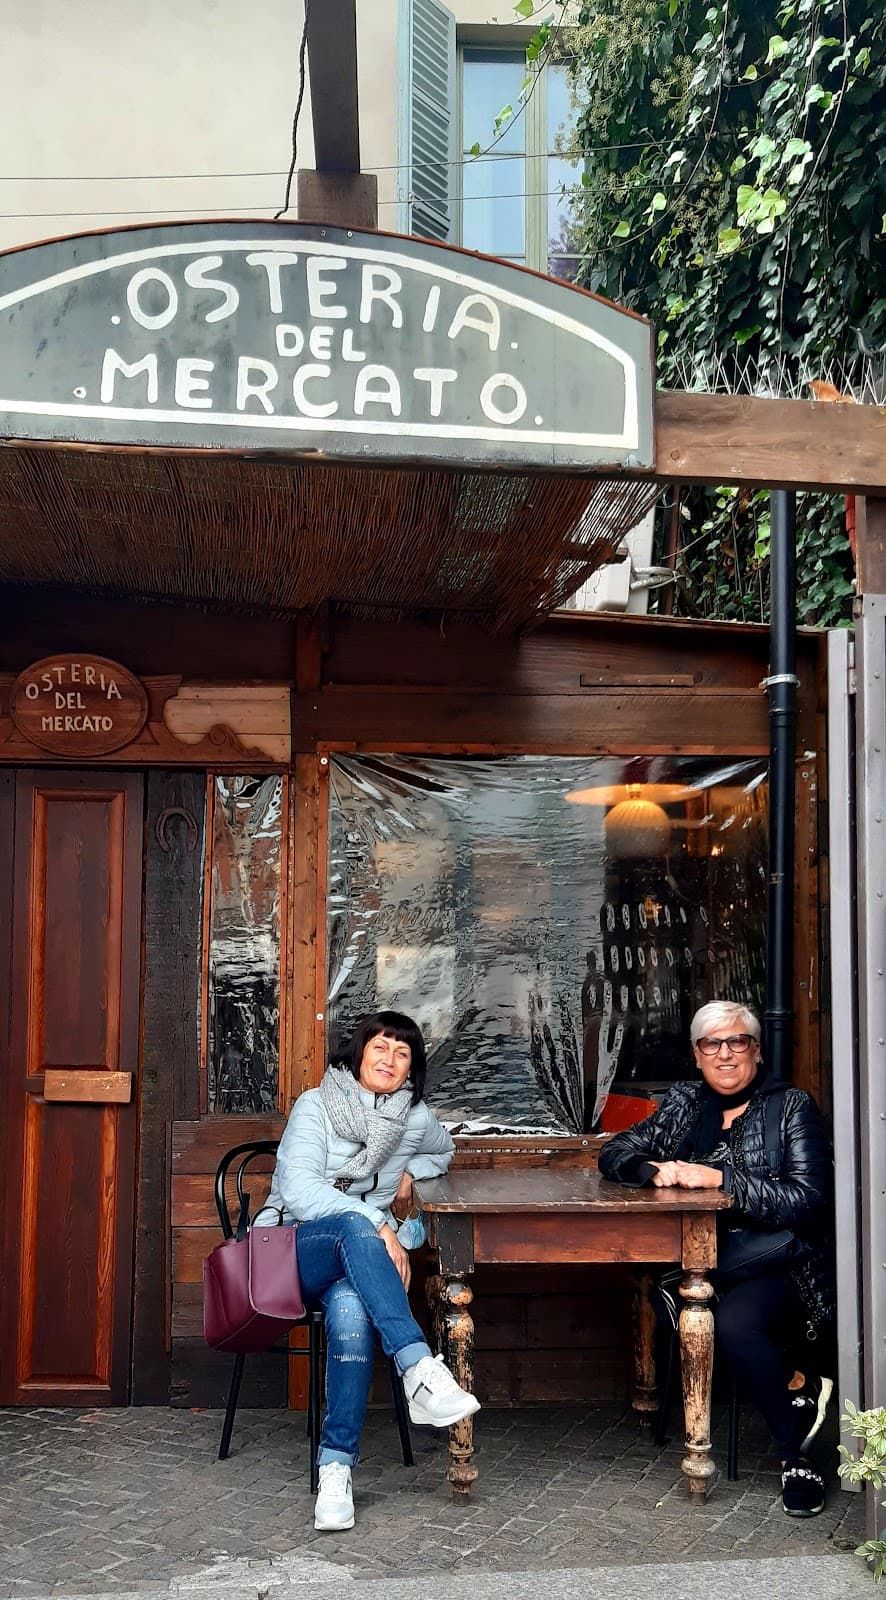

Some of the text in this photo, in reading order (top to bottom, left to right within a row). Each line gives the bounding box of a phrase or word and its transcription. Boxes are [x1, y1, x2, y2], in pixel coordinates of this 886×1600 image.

[276, 324, 366, 362] DEL
[25, 663, 122, 699] OSTERIA
[55, 692, 86, 710] DEL
[41, 715, 113, 732] MERCATO
